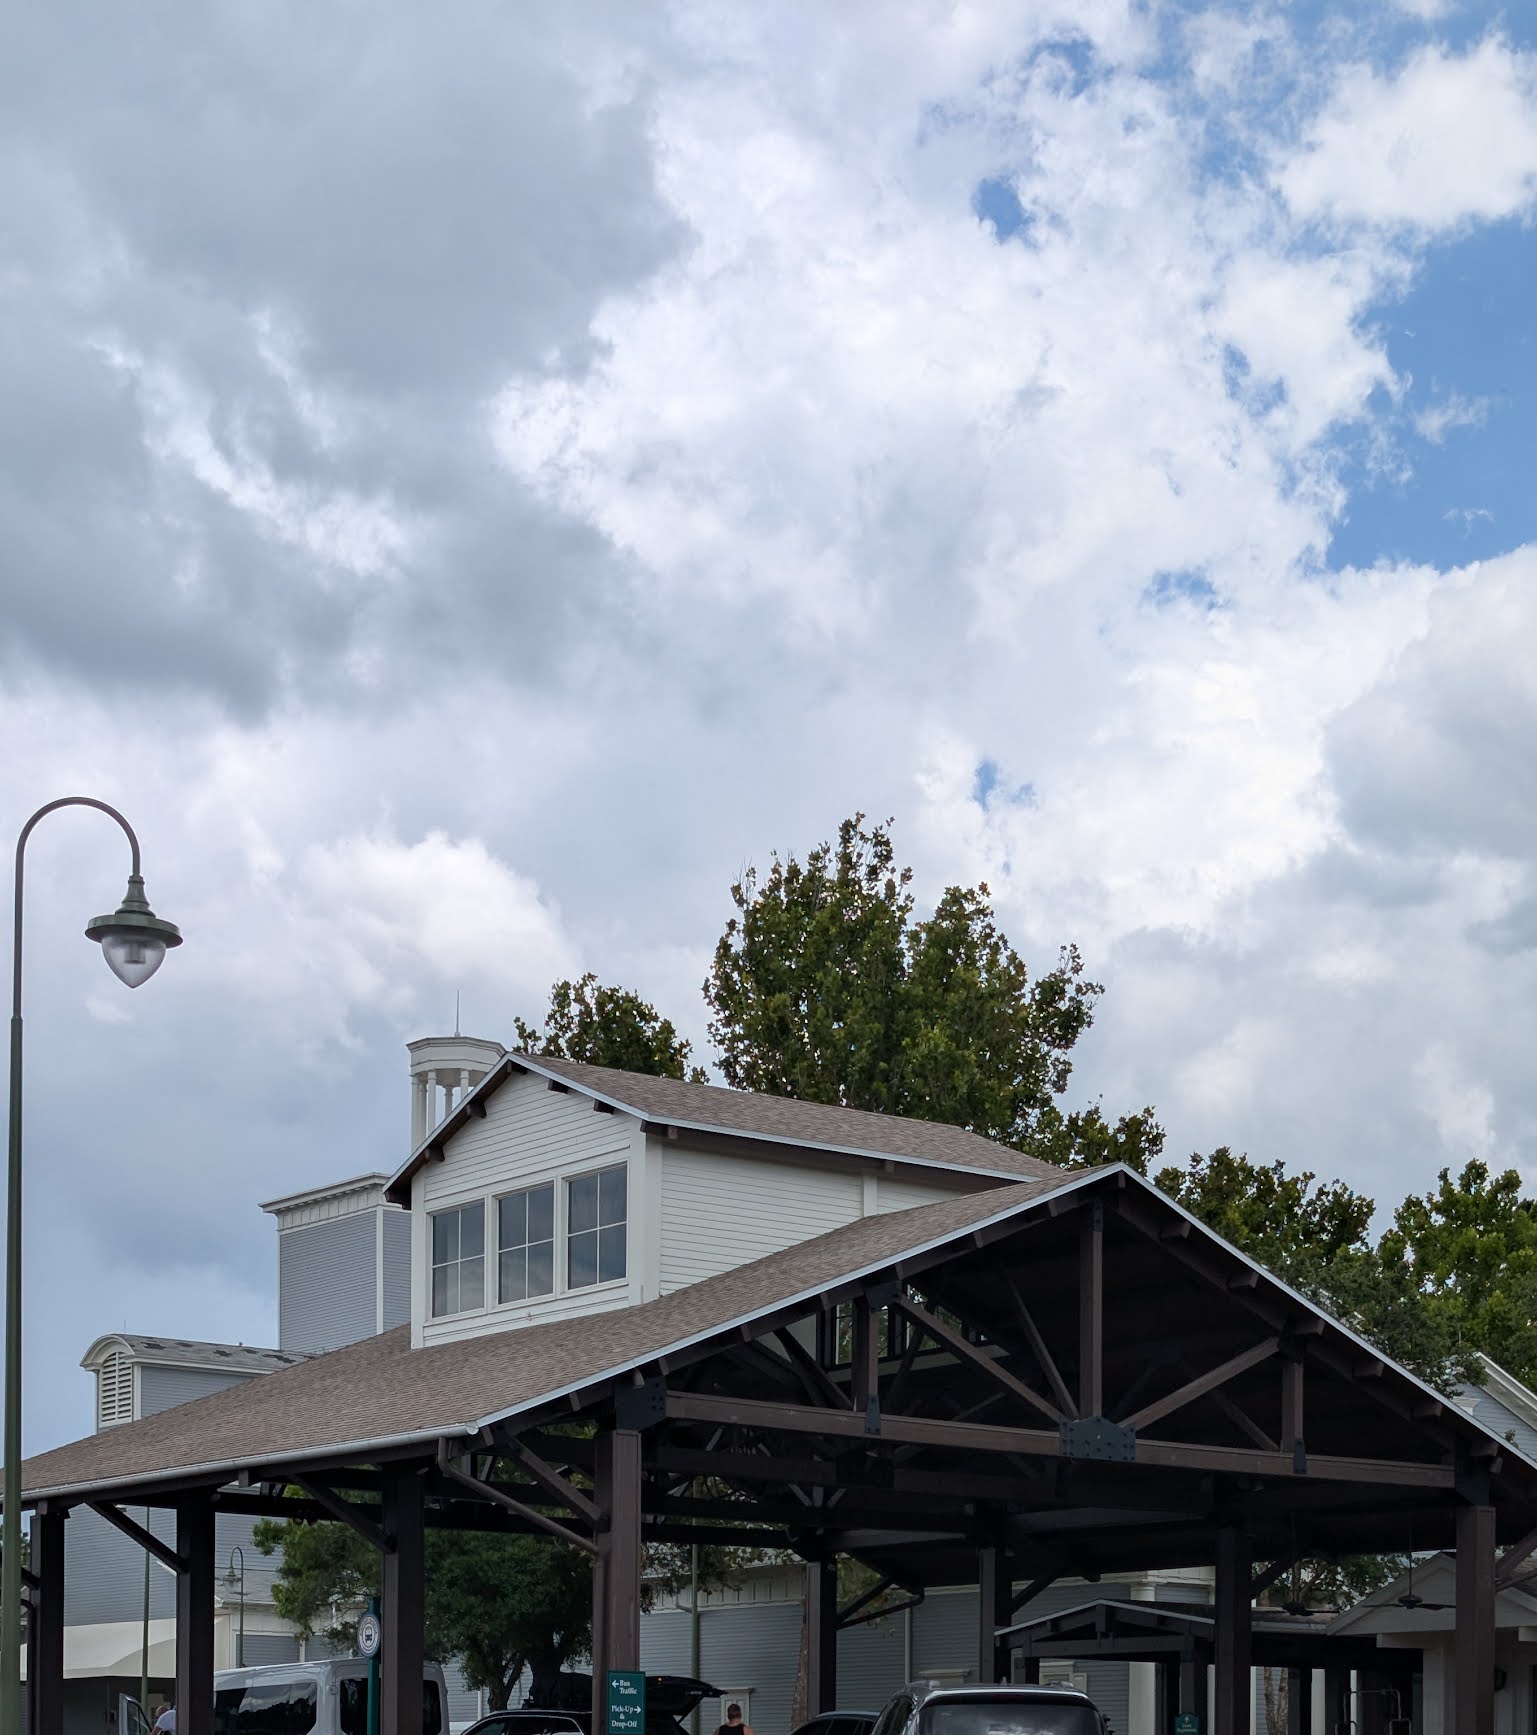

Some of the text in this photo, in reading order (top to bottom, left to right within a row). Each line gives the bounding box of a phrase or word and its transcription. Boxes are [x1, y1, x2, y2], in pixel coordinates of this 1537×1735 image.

[619, 1687, 638, 1695] Traffic
[611, 1705, 634, 1714] Pick-Up
[611, 1720, 638, 1729] Drop-Off
